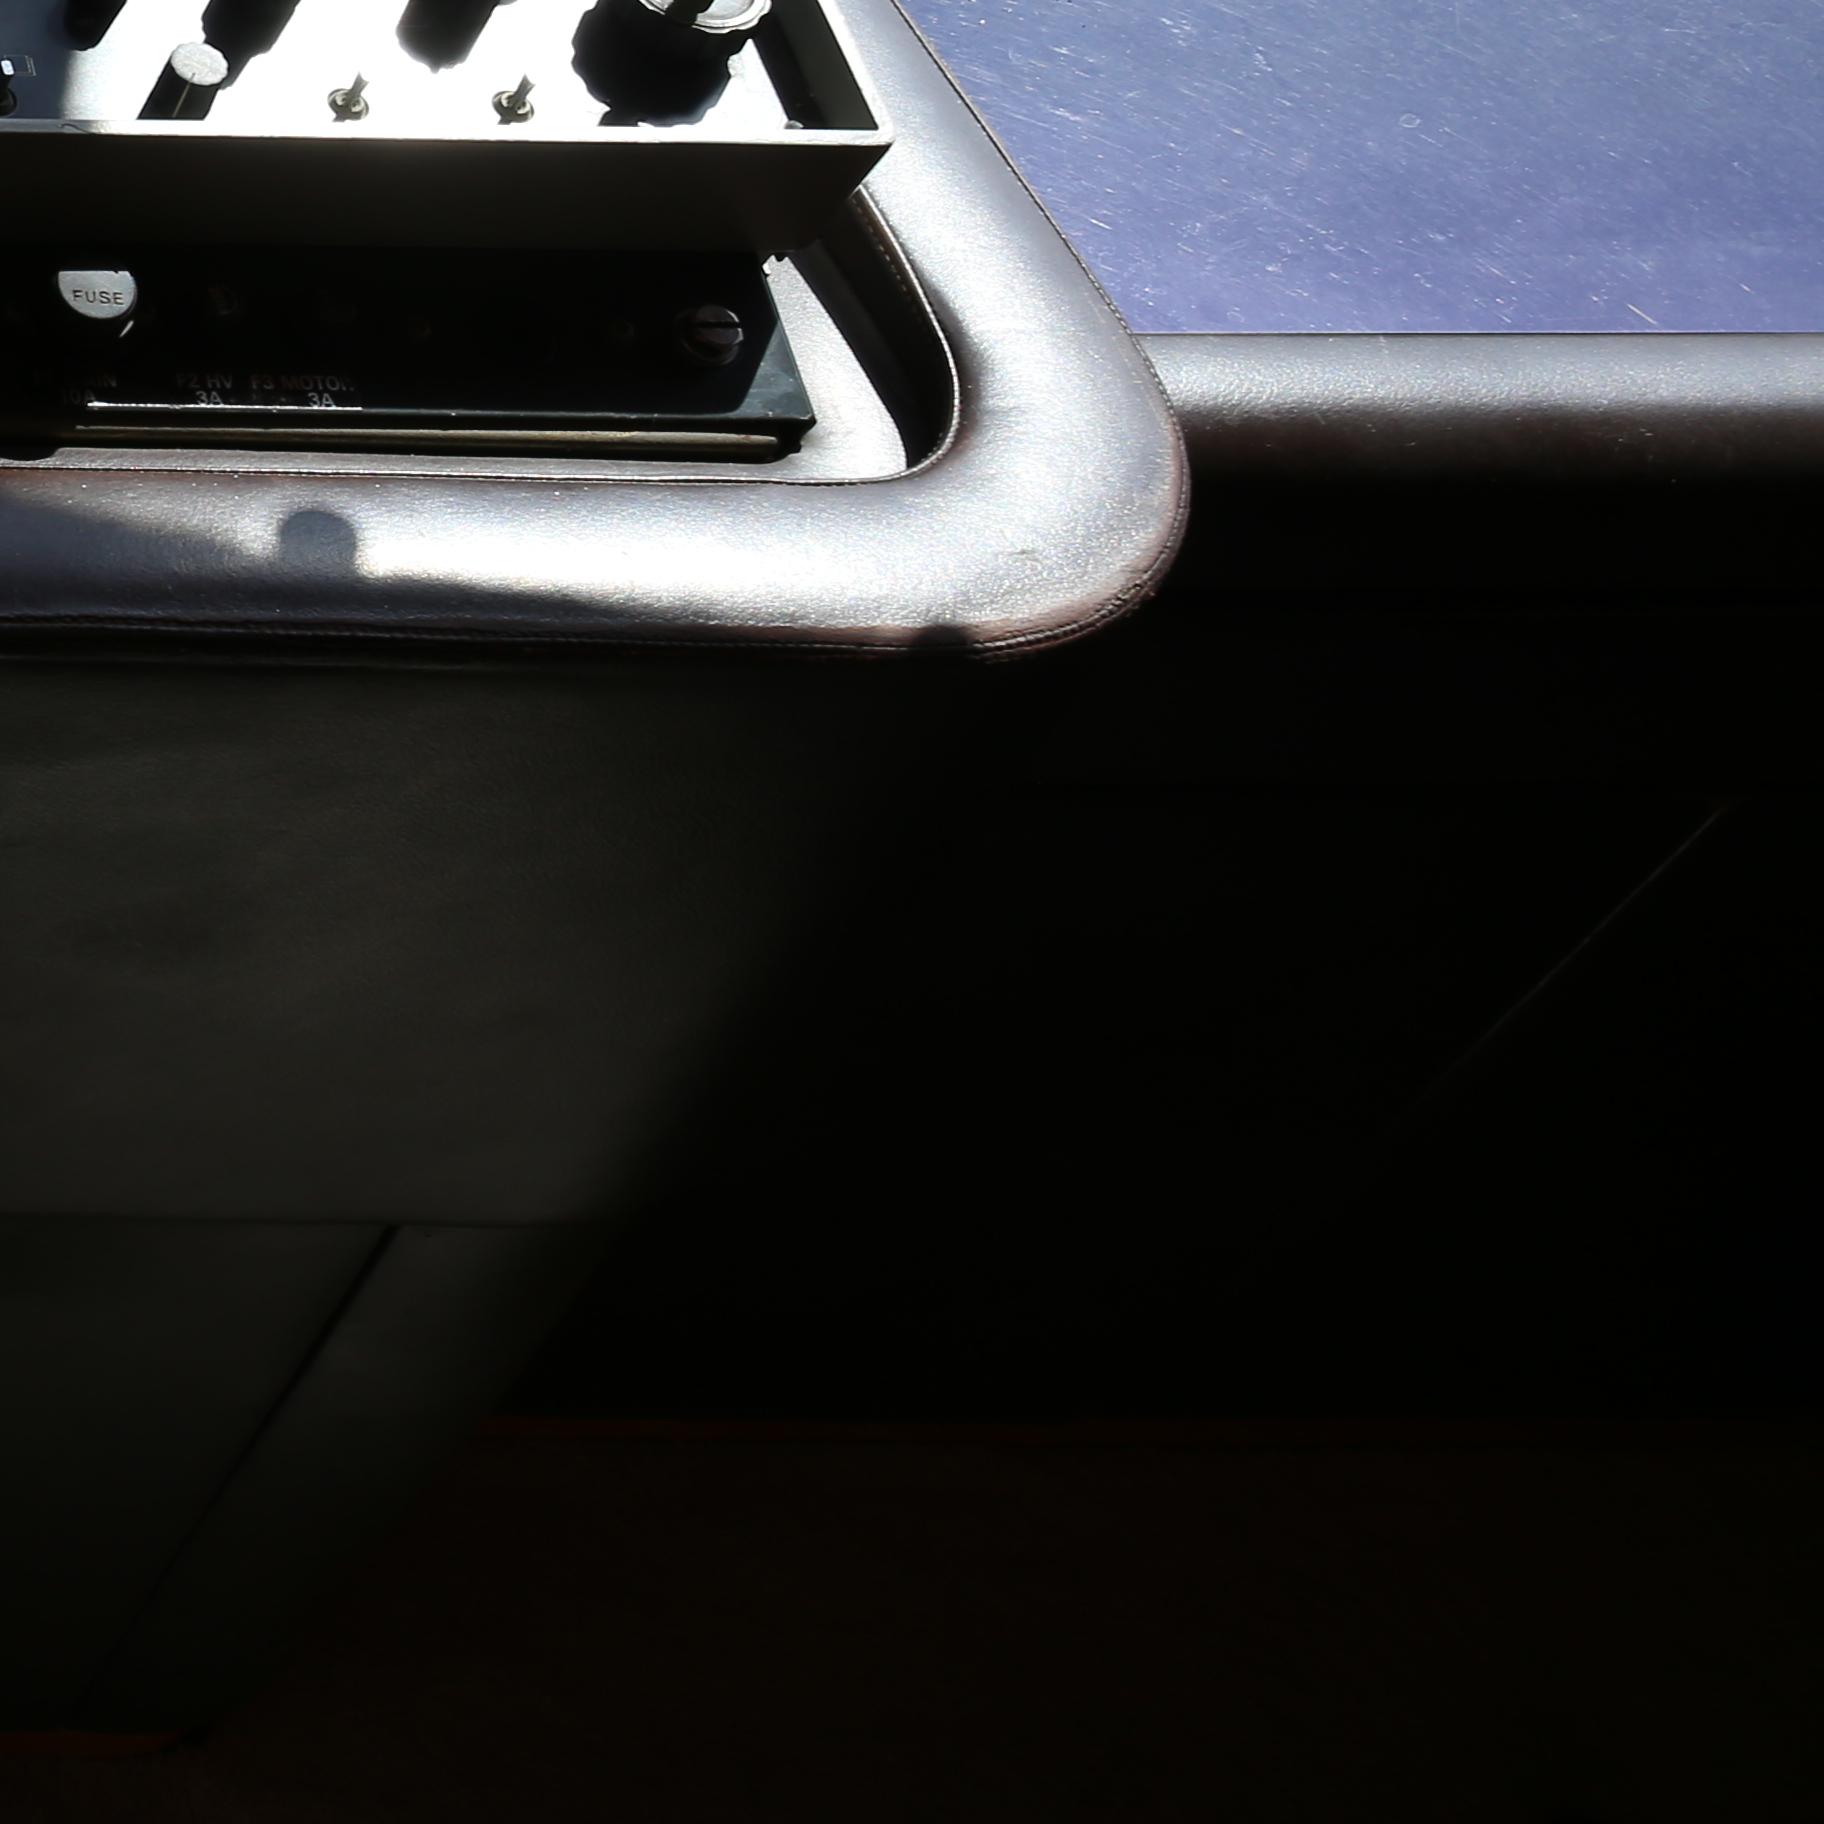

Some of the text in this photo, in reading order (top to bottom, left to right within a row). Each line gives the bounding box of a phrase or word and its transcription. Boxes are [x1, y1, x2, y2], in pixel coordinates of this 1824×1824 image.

[72, 288, 125, 306] FUSE
[176, 372, 234, 388] F2 HV
[249, 373, 273, 389] F3
[196, 389, 225, 406] 3A
[307, 390, 337, 407] 3A
